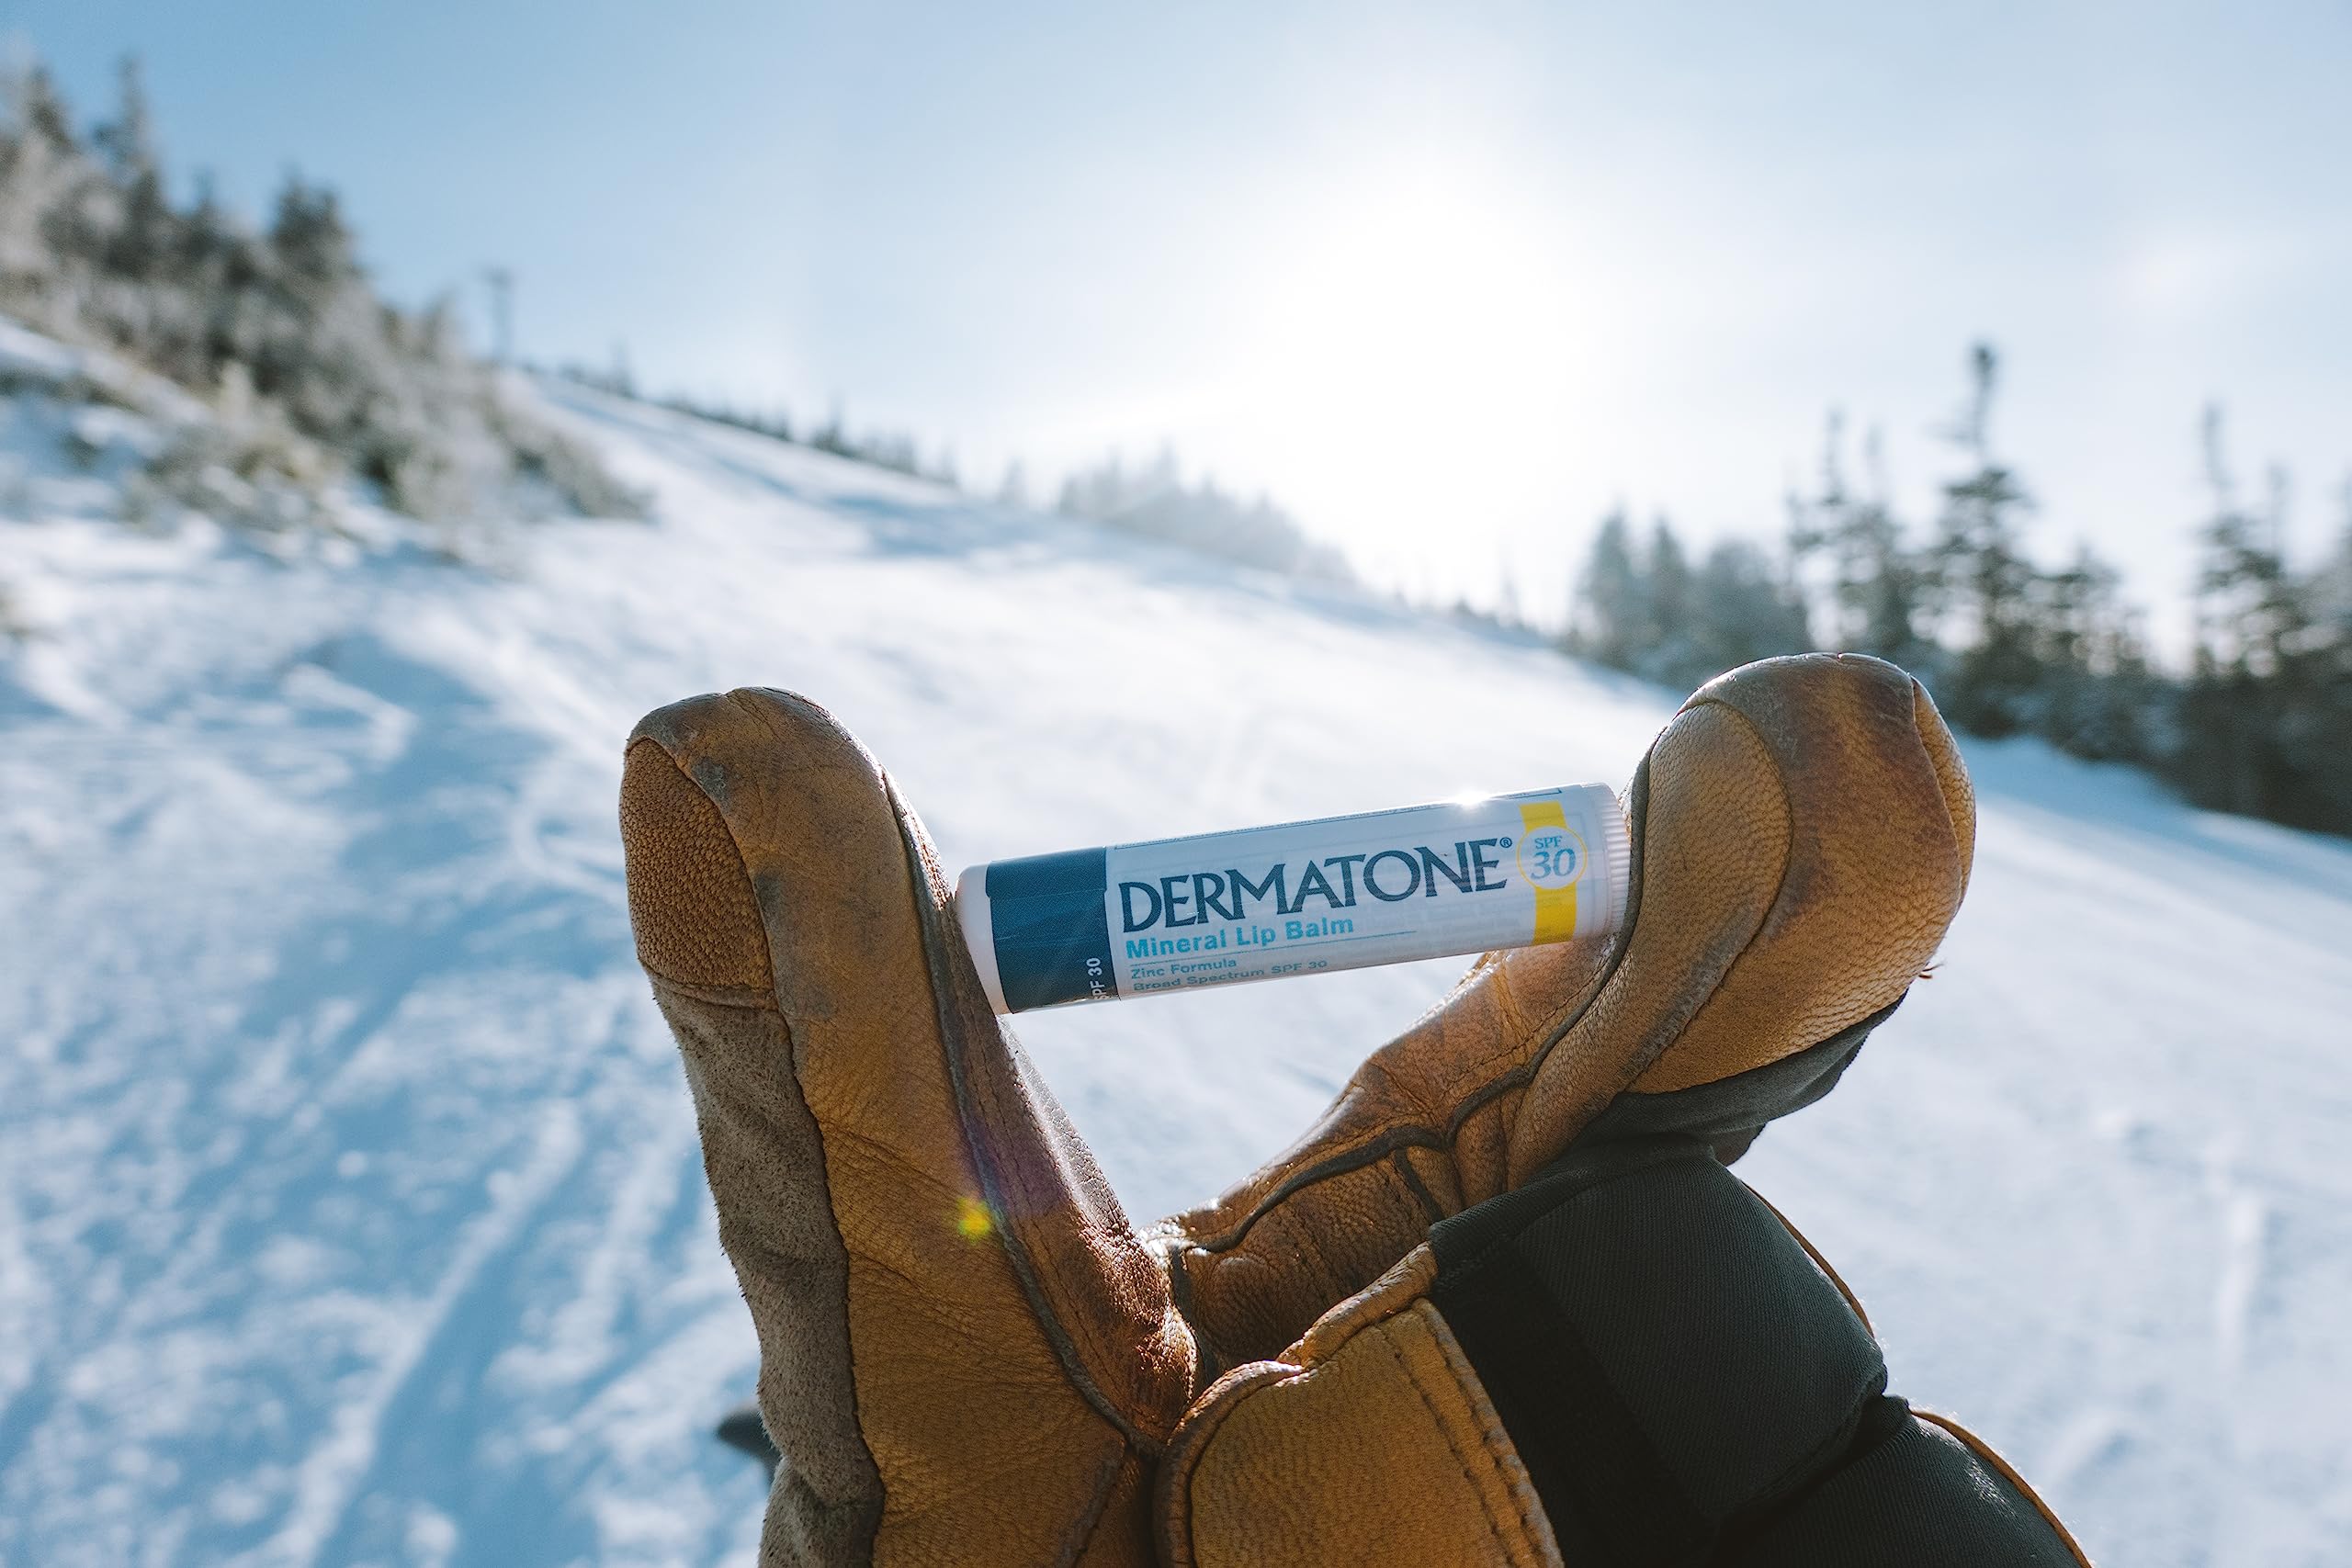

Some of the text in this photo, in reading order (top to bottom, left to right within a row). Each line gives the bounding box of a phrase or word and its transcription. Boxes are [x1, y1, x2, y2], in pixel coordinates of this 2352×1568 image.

[1534, 835, 1563, 850] SPF
[1531, 848, 1577, 880] 30
[1125, 917, 1354, 959] Mineral Lip Balm
[1086, 957, 1102, 976] 30
[1131, 959, 1237, 979] Zinc Formula
[1133, 960, 1329, 991] Broad Spectrum SPF 30
